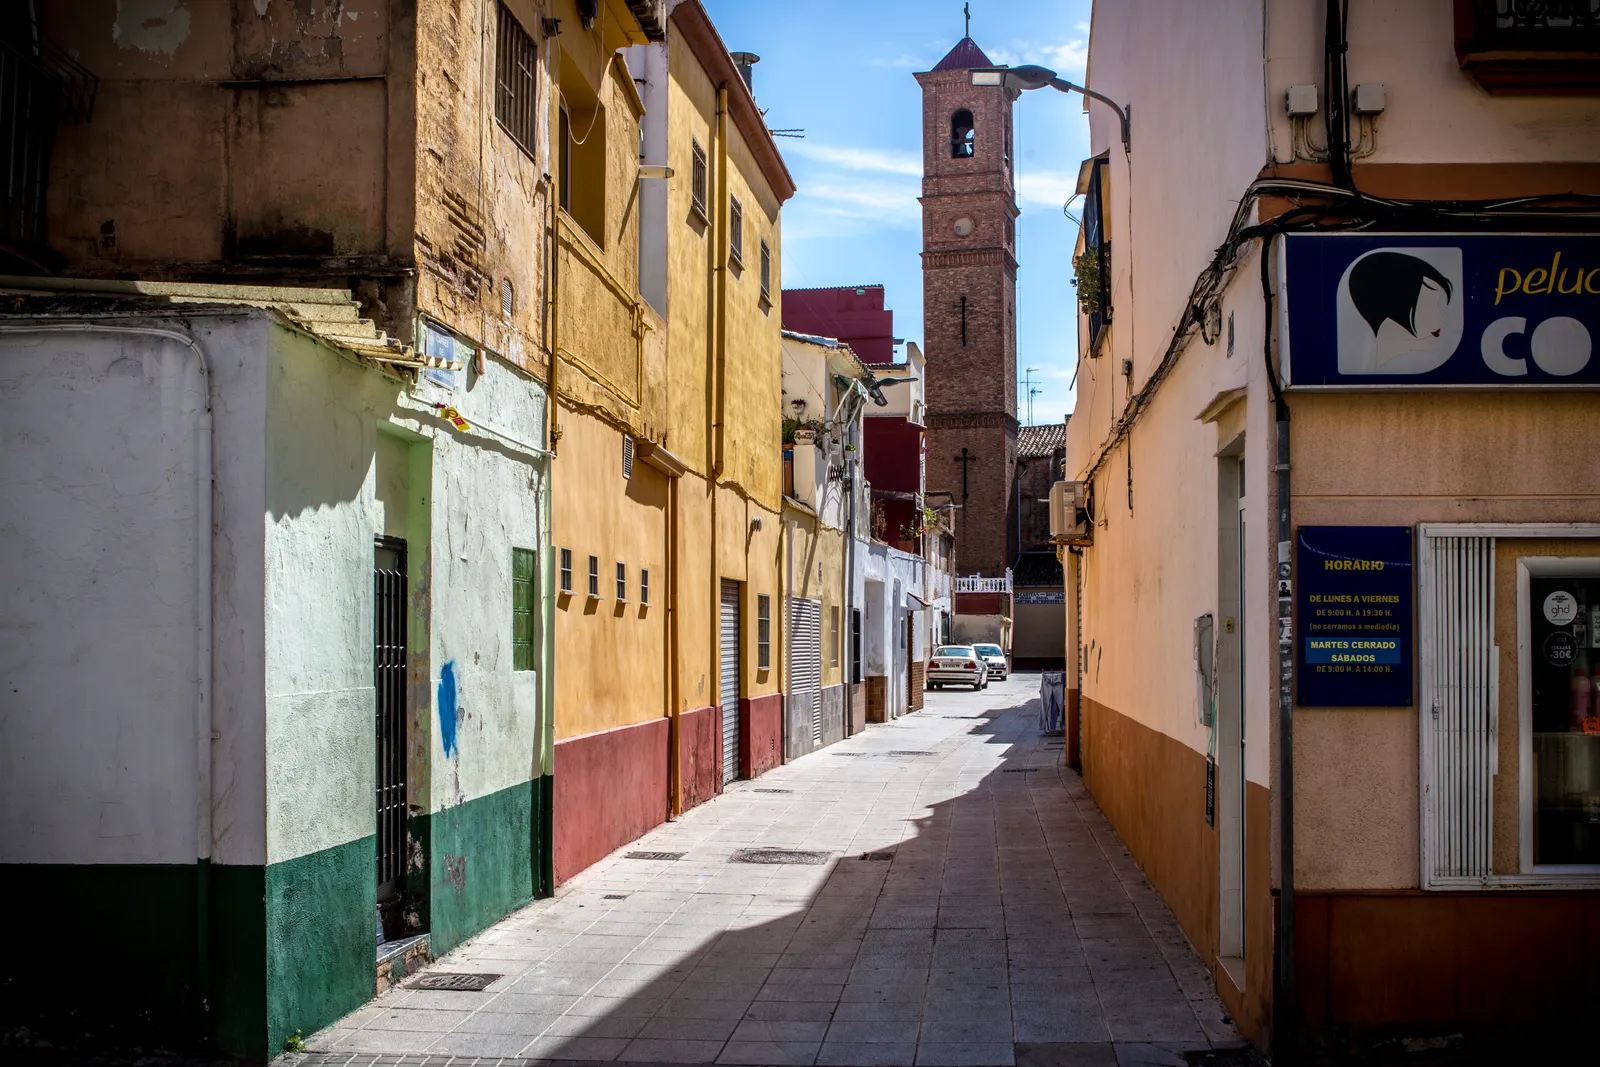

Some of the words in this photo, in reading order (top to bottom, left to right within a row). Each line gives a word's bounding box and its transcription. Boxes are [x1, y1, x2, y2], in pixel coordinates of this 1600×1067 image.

[1324, 559, 1385, 571] HORARIO
[1309, 595, 1322, 603] DE
[1323, 595, 1352, 603] LUNES
[1353, 595, 1360, 603] A
[1361, 595, 1400, 603] VIERNES
[1551, 604, 1571, 617] ghd
[1309, 622, 1321, 631] (no
[1310, 641, 1349, 649] MARTES
[1351, 641, 1396, 649] CERRADO
[1331, 653, 1376, 662] SÁBADOS
[1550, 650, 1572, 659] -30€
[1316, 665, 1326, 673] DE
[1327, 665, 1344, 673] 9:00
[1346, 665, 1354, 673] H.
[1355, 665, 1361, 673] A
[1363, 665, 1383, 673] 14:00
[1385, 665, 1392, 673] H.
